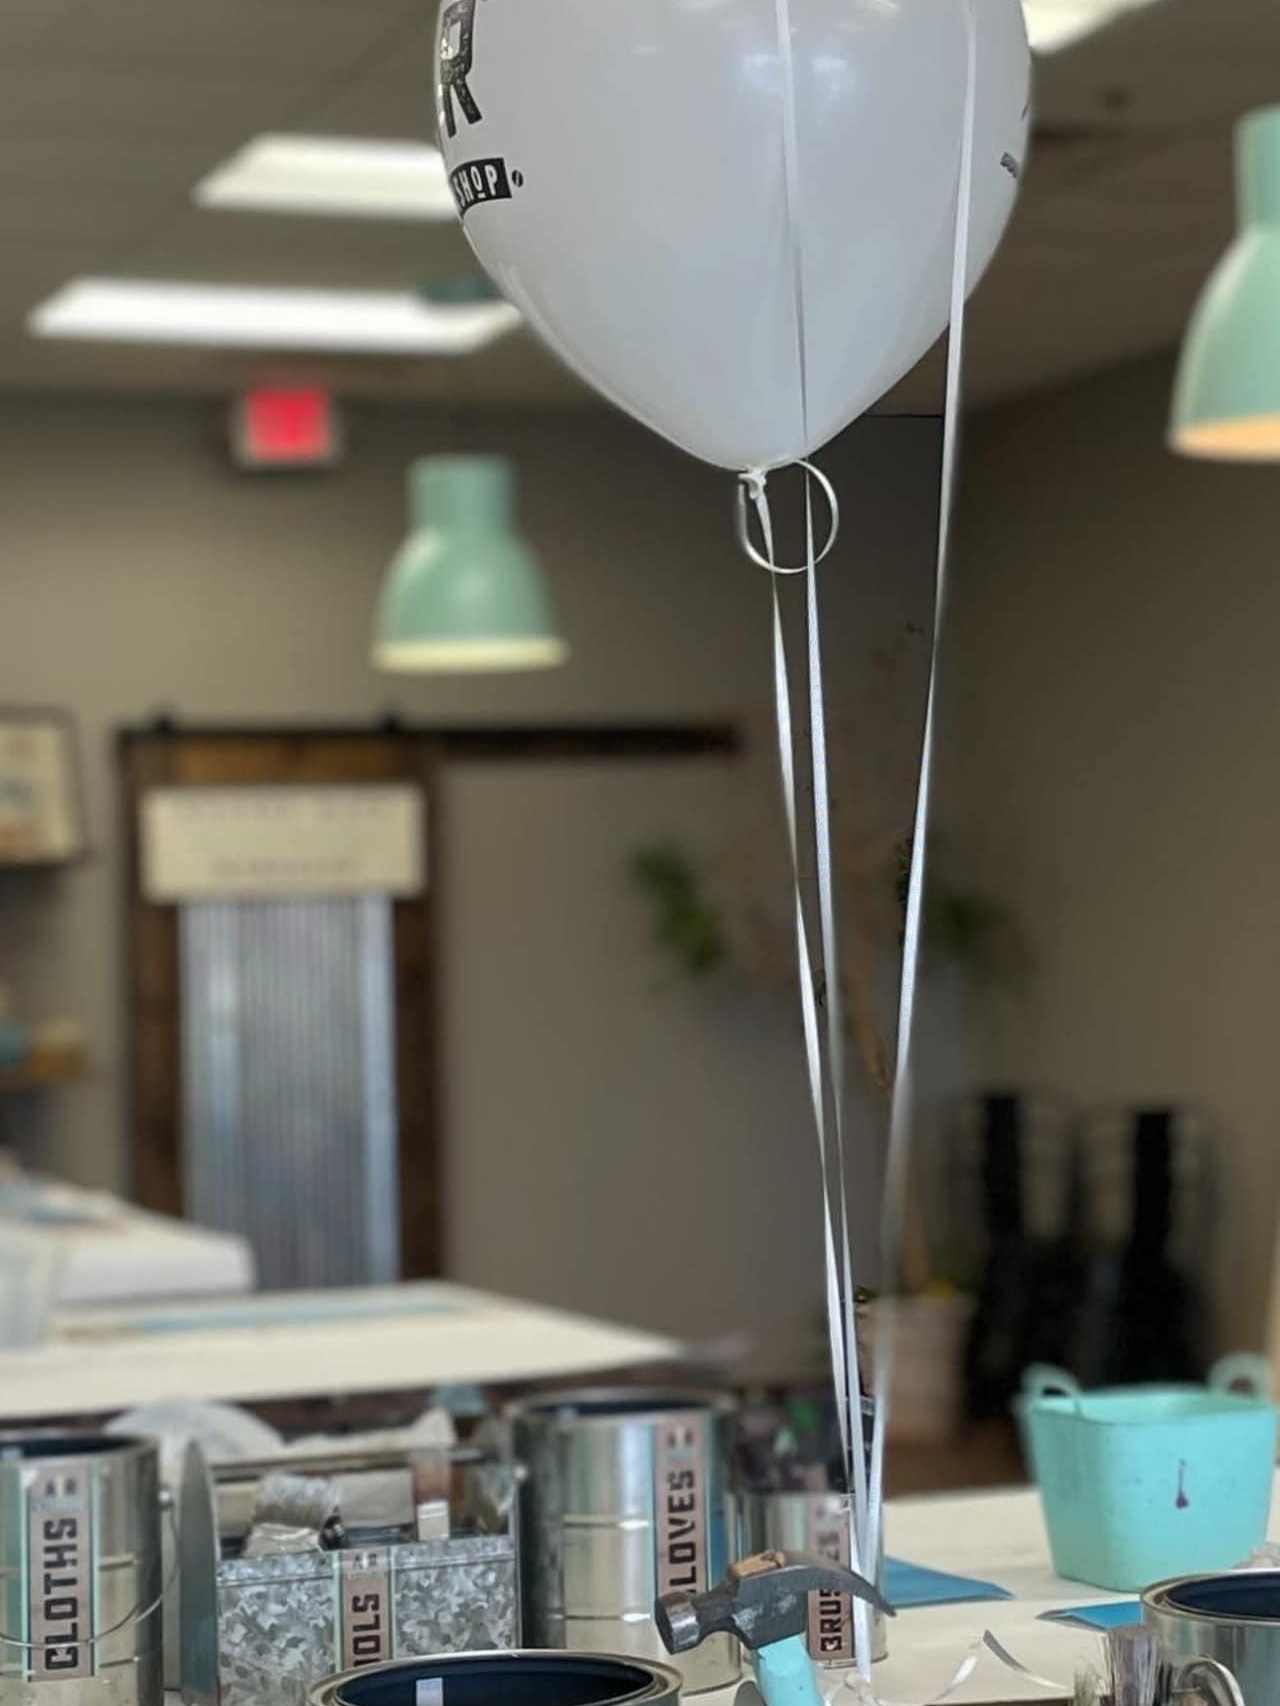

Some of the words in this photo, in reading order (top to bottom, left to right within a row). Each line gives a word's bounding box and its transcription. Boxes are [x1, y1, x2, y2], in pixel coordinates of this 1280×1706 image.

[667, 1468, 697, 1593] LOVES
[43, 1517, 78, 1671] CLOTHS
[351, 1593, 381, 1668] OLS
